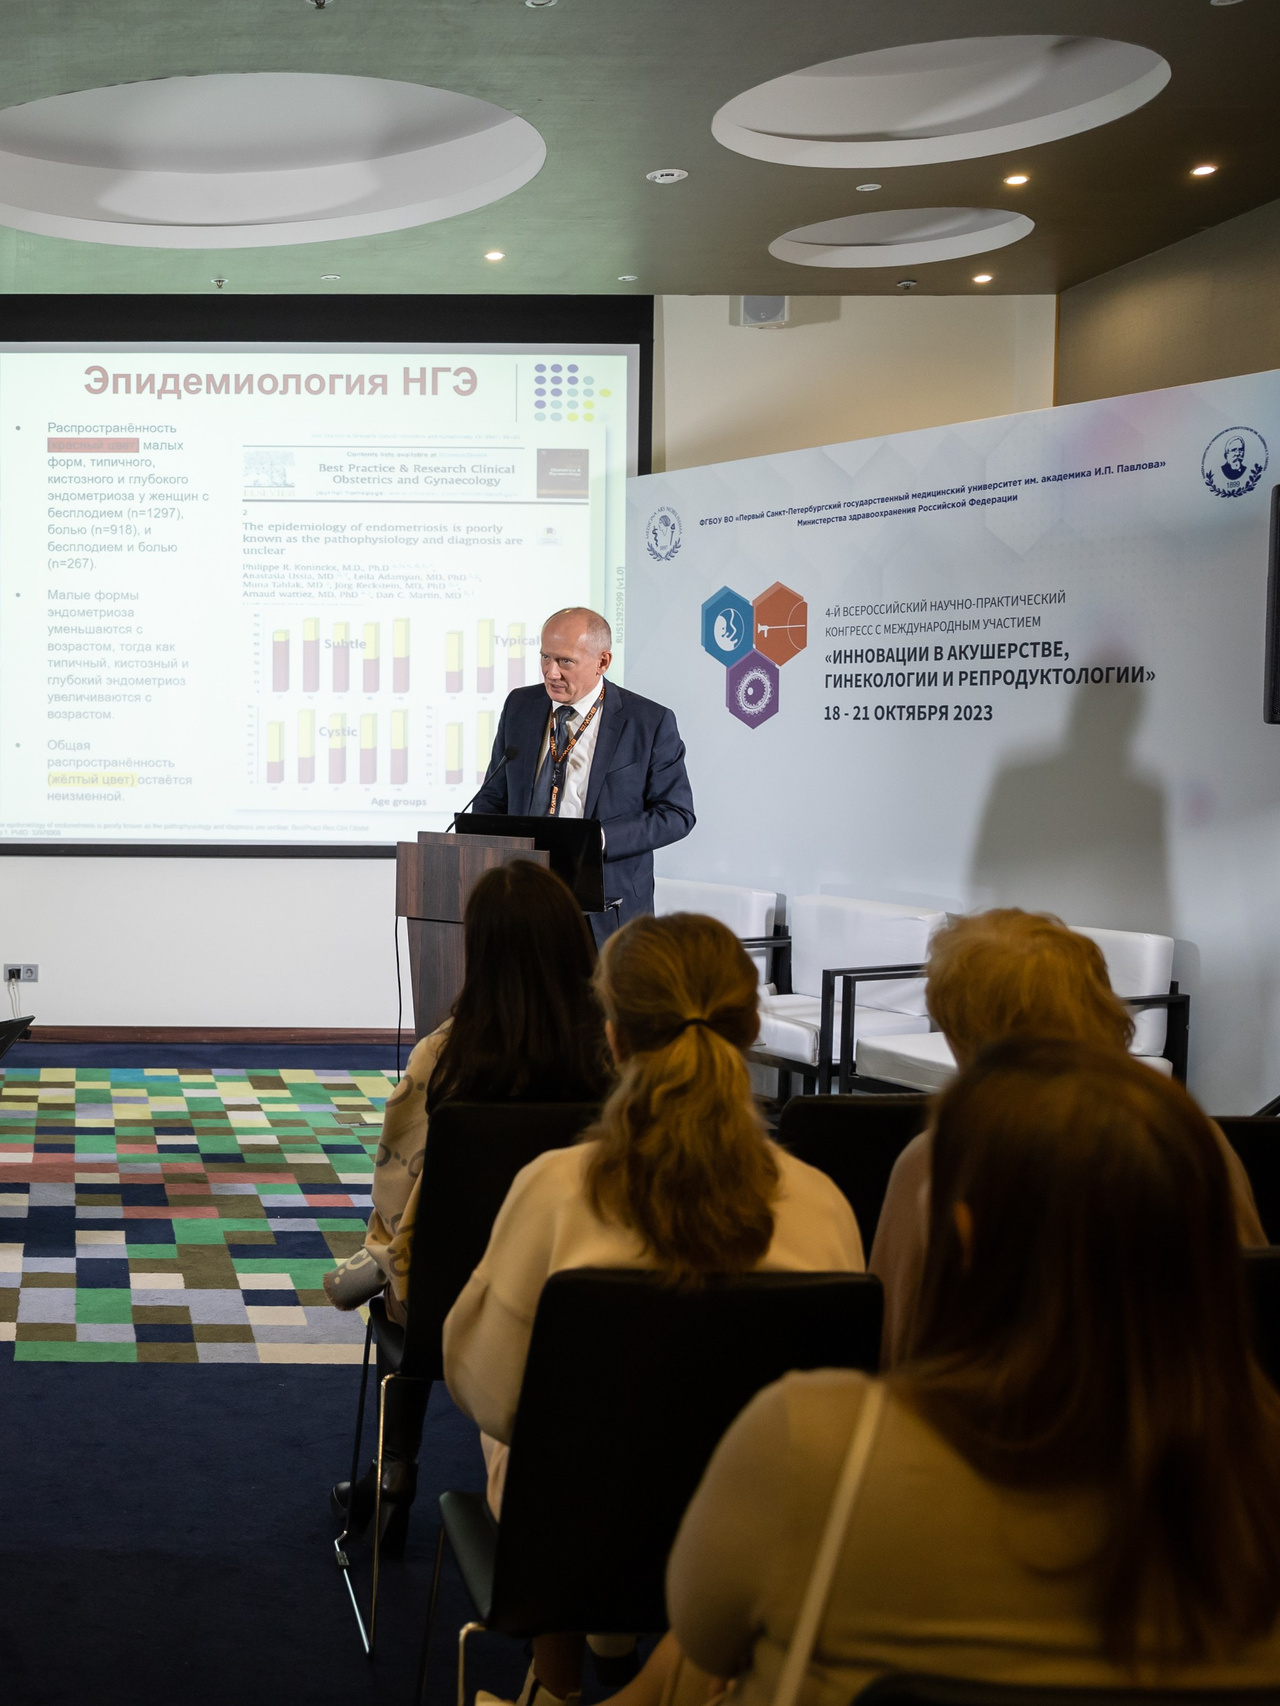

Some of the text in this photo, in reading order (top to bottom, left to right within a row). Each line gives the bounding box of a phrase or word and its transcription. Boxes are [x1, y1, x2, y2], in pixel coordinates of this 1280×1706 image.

[84, 365, 477, 400] Эпидемиология НГЭ
[47, 421, 177, 435] Распространённость
[142, 441, 184, 450] малых
[47, 455, 155, 469] форм, типичного,
[318, 462, 515, 473] Best Practice & Research Clinical
[47, 473, 188, 486] кистозного и глубокого
[332, 473, 501, 488] Obstetrics and Gynaecology
[47, 491, 209, 504] эндометриоза у женщин с
[699, 514, 722, 525] ФГБОУ
[723, 513, 733, 522] ВО
[735, 509, 764, 522] «Первый
[765, 500, 841, 517] Санкт-Петербургский
[842, 491, 909, 508] государственный
[911, 484, 965, 499] медицинский
[967, 479, 1022, 494] университет
[1040, 470, 1091, 482] академика
[1094, 465, 1113, 475] И.П.
[1116, 460, 1166, 472] Павлова»
[47, 506, 183, 520] бесплодием (n=1297),
[797, 494, 1017, 526] Министерства здравоохранения Российской Федерации
[47, 523, 151, 536] болью (n=918), и
[241, 521, 503, 534] The epidemiology of endometriosis is poorly
[242, 533, 523, 546] known as the pathophysiology and diagnosis are
[47, 540, 177, 553] бесплодием и болью
[242, 545, 285, 554] unclear
[47, 556, 96, 571] (n=267).
[47, 588, 139, 603] Малые формы
[825, 589, 1065, 617] 4-Й ВСЕРОССИЙСКИЙ НАУЧНО-ПРАКТИЧЕСКИЙ
[47, 608, 134, 620] эндометриоза
[46, 625, 143, 636] уменьшаются с
[825, 616, 1041, 637] КОНГРЕСС С МЕЖДУНАРОДНЫМ УЧАСТИЕМ
[47, 642, 175, 653] возрастом, тогда как
[324, 637, 367, 649] Subtle
[492, 634, 540, 648] Typical
[824, 641, 1069, 665] «ИННОВАЦИИ В АКУШЕРСТВЕ,
[47, 657, 188, 669] типичный, кистозный и
[47, 673, 185, 688] глубокий эндометриоз
[825, 665, 1155, 688] ГИНЕКОЛОГИИ И РЕПРОДУКТОЛОГИИ»
[46, 693, 152, 704] увеличиваются с
[46, 710, 114, 721] возрастом.
[823, 705, 992, 720] 18 21 ОКТЯБРЯ 2023
[318, 726, 358, 739] Cystic
[46, 738, 90, 752] Общая
[46, 756, 175, 770] распространённость
[47, 774, 192, 787] (жёлтый цвет) остаётся
[46, 790, 124, 800] неизменной.
[370, 796, 428, 809] Age groups
